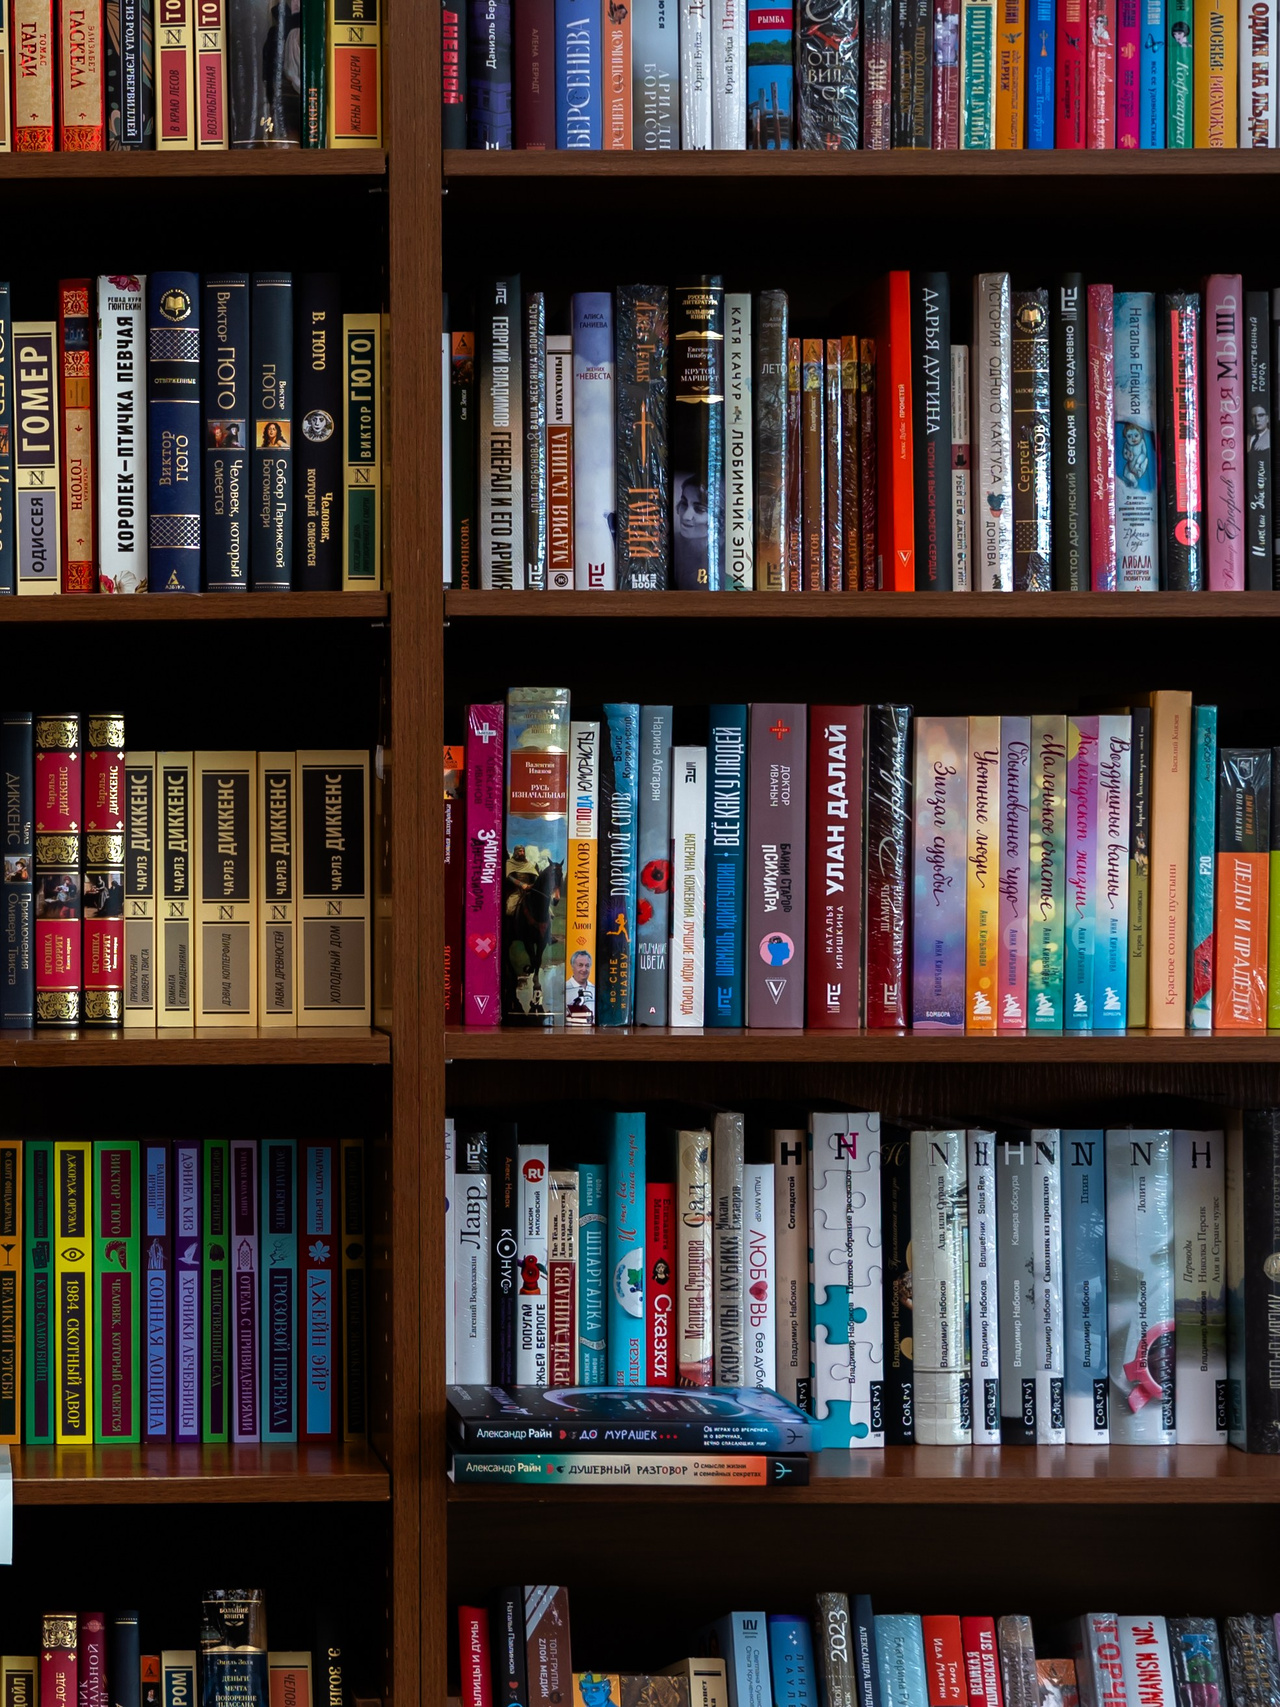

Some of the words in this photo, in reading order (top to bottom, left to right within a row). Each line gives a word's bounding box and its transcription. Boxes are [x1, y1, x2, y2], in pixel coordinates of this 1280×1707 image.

[757, 15, 785, 24] РЫМБА
[1251, 1, 1270, 57] ОДИН
[21, 21, 37, 79] ГАРДИ
[69, 8, 86, 90] ГАСКЕЛЛ
[1251, 62, 1270, 90] НА
[731, 307, 741, 344] КАТЯ
[922, 287, 940, 352] ДАРЬЯ
[1130, 308, 1141, 359] Наталья
[117, 316, 134, 384] ПЕВЧАЯ
[350, 338, 372, 402] ГЮГО
[731, 351, 741, 400] КАЧУР
[1067, 326, 1076, 395] ежедневно
[20, 345, 50, 452] ГОМЕР
[217, 347, 236, 410] ГЮГО
[555, 356, 563, 422] АВТОХТОНЫ
[922, 355, 941, 436] ДУГИНА
[1130, 360, 1141, 415] Елецкая
[361, 406, 370, 457] ВИКТОР
[1067, 415, 1076, 465] сегодня
[215, 461, 223, 514] смеется
[231, 460, 243, 517] Человек,
[550, 431, 569, 504] ГАЛИНА
[32, 498, 44, 572] ОДИССЕЯ
[231, 522, 240, 577] который
[550, 510, 569, 563] МАРИЯ
[712, 726, 742, 775] ЛЮДЕЙ
[823, 724, 849, 819] ДАЛАЙ
[325, 774, 345, 851] ДИККЕНС
[610, 791, 631, 828] СНОВ
[714, 790, 741, 819] КАК
[973, 747, 999, 824] Уютные
[1100, 735, 1130, 839] Воздушные
[710, 820, 741, 847] ВСЁ
[826, 824, 845, 897] УЛАН
[969, 829, 989, 889] люди
[332, 855, 341, 891] ЧАРЛЗ
[573, 842, 590, 919] ИЗМАЙЛОВ
[607, 830, 631, 898] ДОРОГОЙ
[761, 844, 778, 913] ПСИХИАТРА
[1105, 842, 1130, 910] ванны
[1200, 856, 1211, 876] F20
[1234, 858, 1251, 913] ДЕДЫ
[331, 925, 340, 947] ДОМ
[1234, 918, 1251, 933] И
[331, 951, 340, 1003] ХОЛОДНЫЙ
[1234, 934, 1251, 1021] ПРАДЕДЫ
[460, 1185, 491, 1250] Лавр
[787, 1176, 795, 1229] Соглядатай
[67, 1279, 78, 1314] 1984.
[586, 1230, 602, 1332] ШПАРГАЛКА
[308, 1275, 327, 1348] ДЖЕЙН
[653, 1293, 672, 1379] Сказки
[65, 1317, 80, 1388] СКОТНЫЙ
[308, 1352, 327, 1392] ЭЙР
[65, 1391, 80, 1430] ДВОР
[476, 1428, 526, 1440] Александр
[529, 1428, 552, 1439] Райн
[580, 1431, 596, 1440] ДО
[568, 1464, 631, 1475] ДУШЕВНЫЙ
[637, 1465, 688, 1475] РАЗГОВОР
[830, 1609, 849, 1663] 2023
[56, 1672, 65, 1701] ДОДЕ
[967, 1651, 984, 1696] ВЕЛИКАЯ
